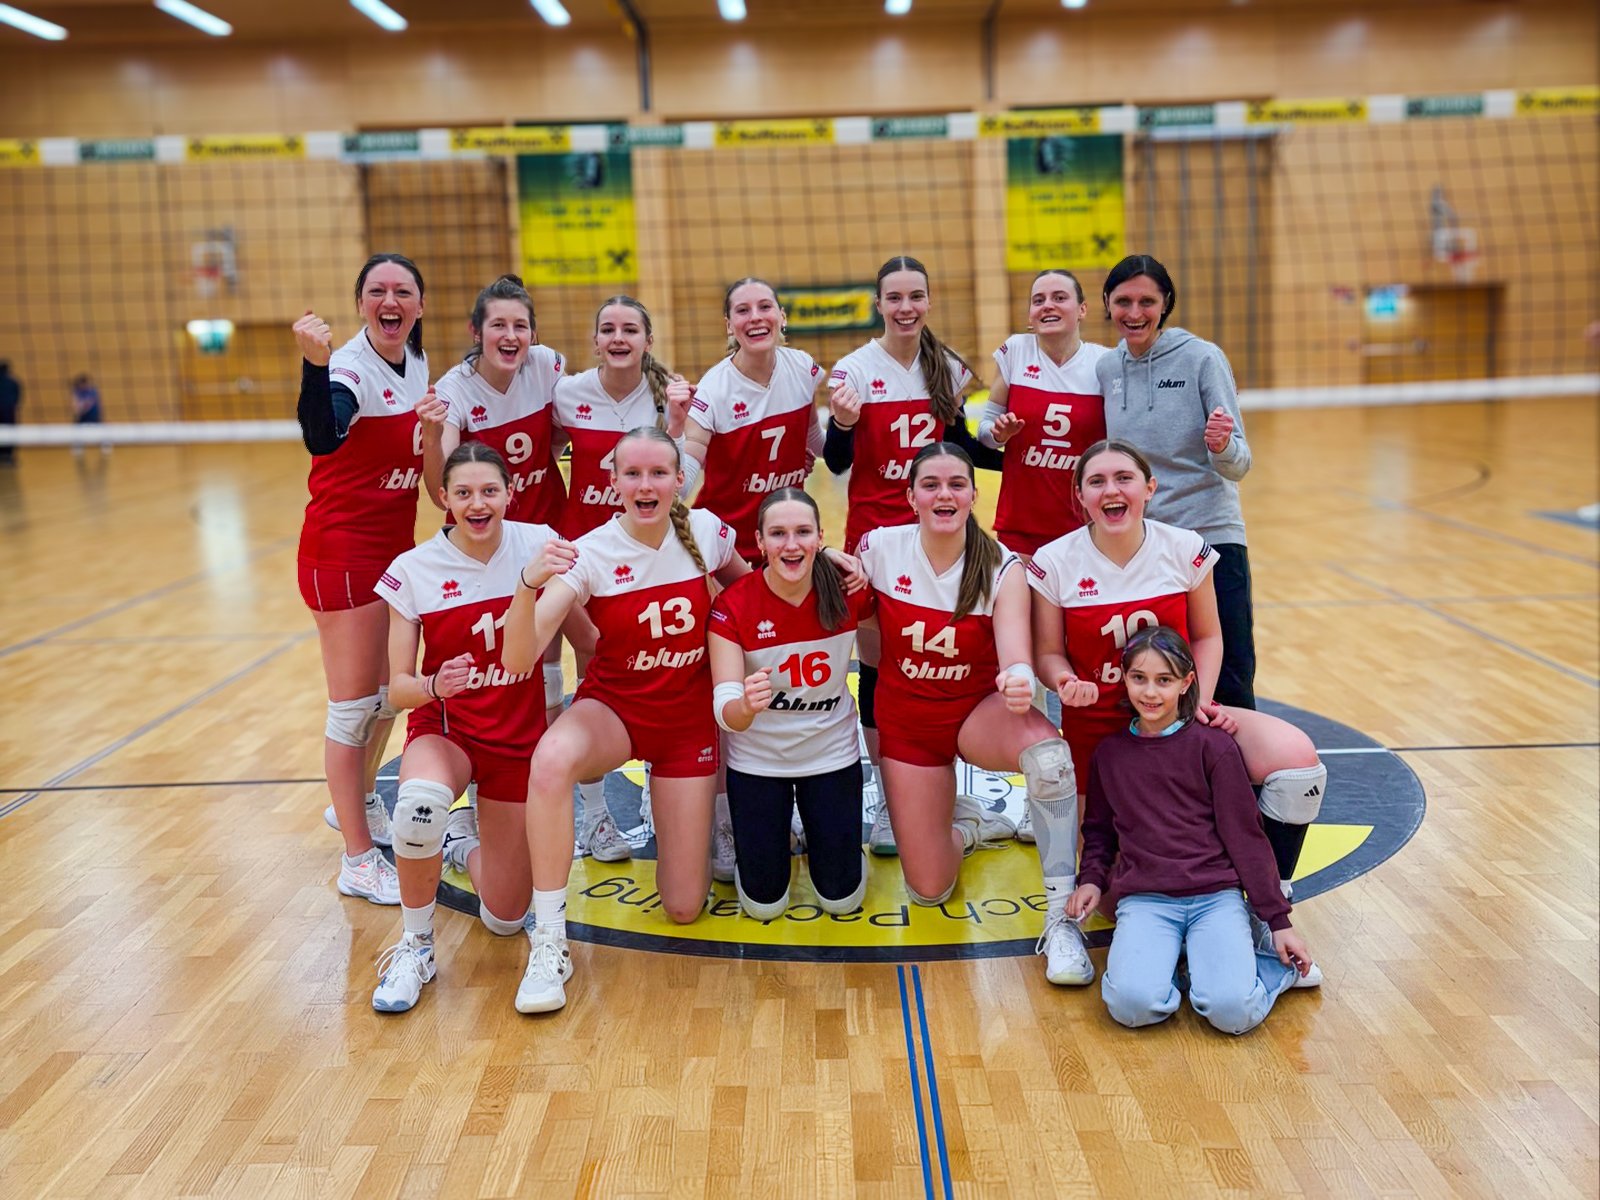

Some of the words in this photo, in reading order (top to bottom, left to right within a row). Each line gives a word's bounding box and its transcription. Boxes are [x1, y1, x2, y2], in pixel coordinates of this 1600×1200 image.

[1158, 379, 1186, 389] blum
[890, 412, 937, 448] 12
[1042, 403, 1073, 437] 5
[505, 432, 533, 465] 9
[761, 425, 786, 461] 7
[512, 467, 548, 492] lum
[748, 468, 805, 493] blum
[884, 459, 913, 480] bl
[582, 485, 624, 506] blu
[615, 575, 635, 585] errea
[894, 585, 912, 595] errea
[442, 590, 462, 600] errea
[1078, 589, 1099, 598] errea
[637, 596, 696, 639] 13
[757, 631, 777, 639] errea
[901, 620, 960, 659] 14
[633, 646, 705, 671] blum
[778, 651, 832, 688] 16
[900, 657, 972, 681] blum
[411, 816, 432, 824] errea
